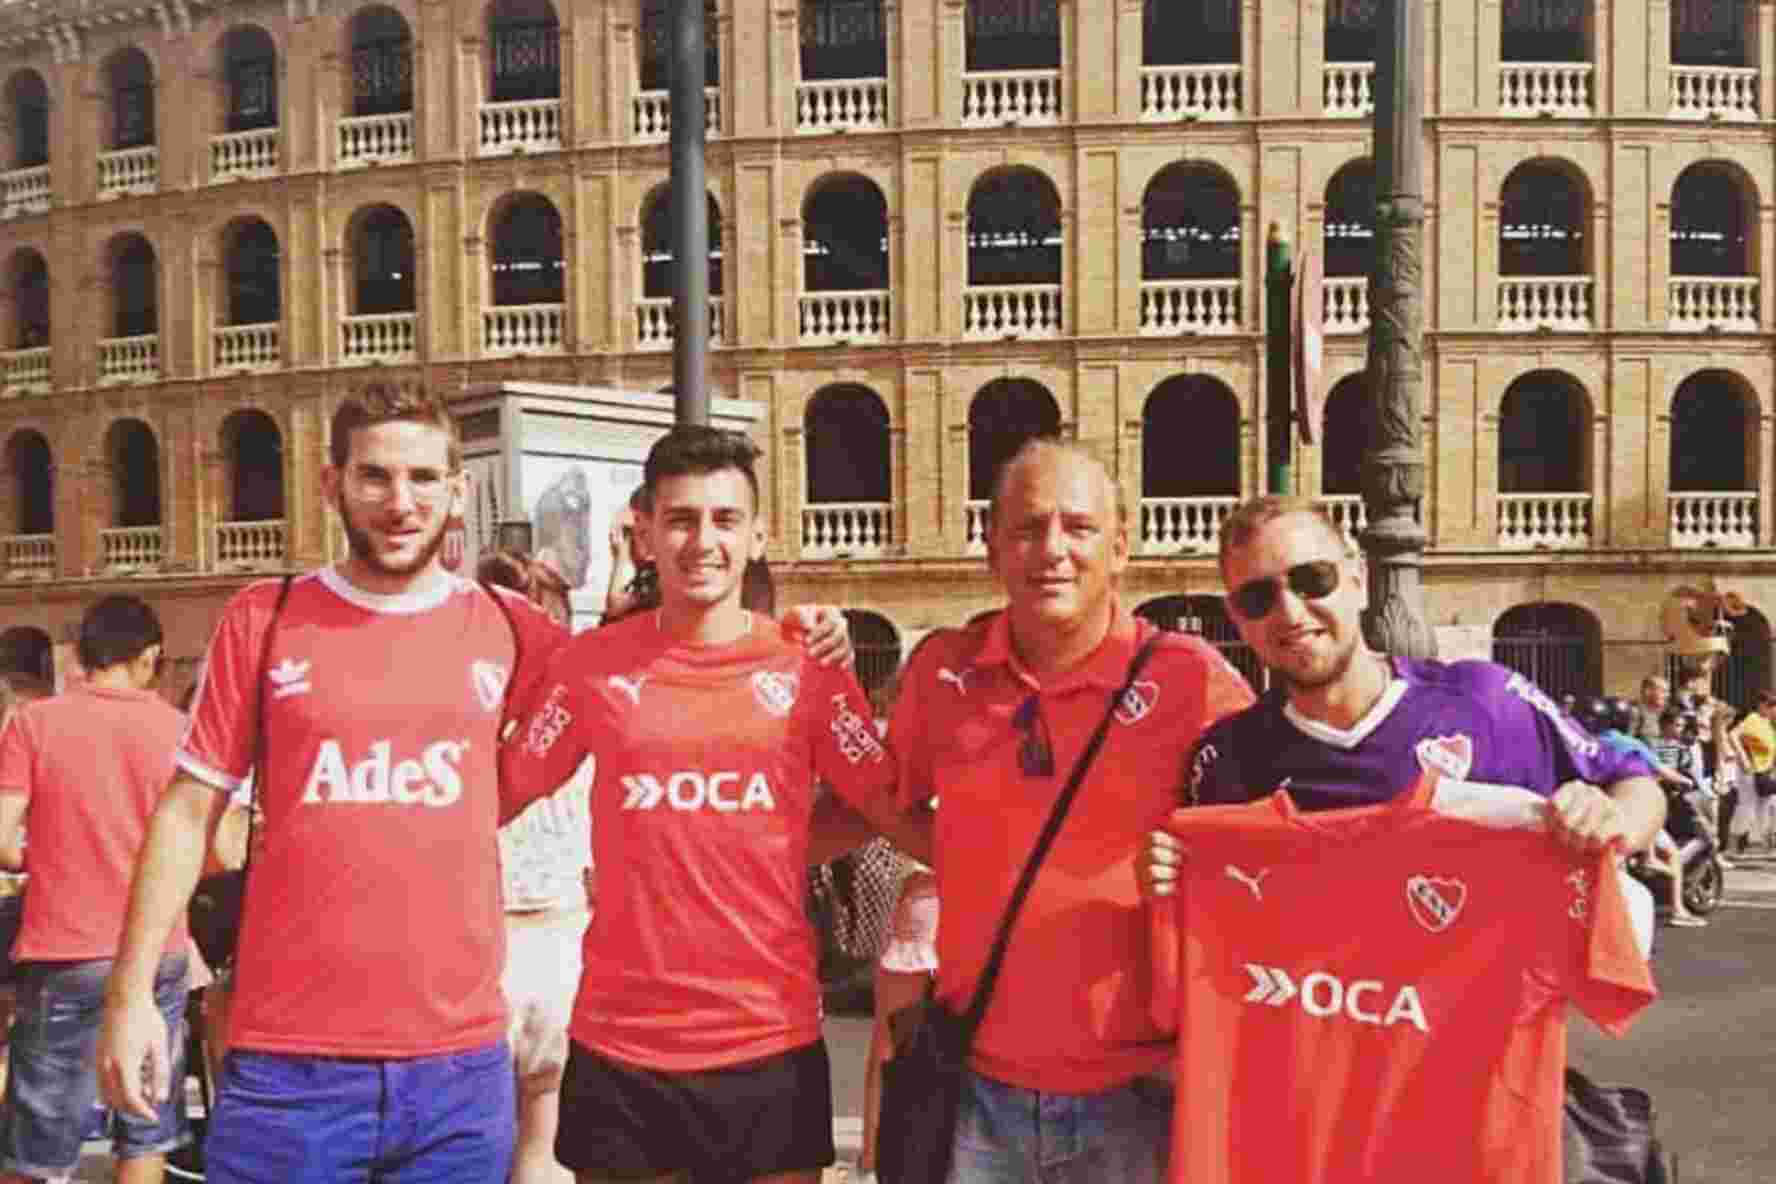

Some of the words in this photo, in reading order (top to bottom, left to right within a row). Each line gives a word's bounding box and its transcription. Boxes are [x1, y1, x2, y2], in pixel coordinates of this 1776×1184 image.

[303, 738, 465, 808] AdeS
[667, 770, 776, 813] OCA
[1301, 972, 1430, 1032] OCA
